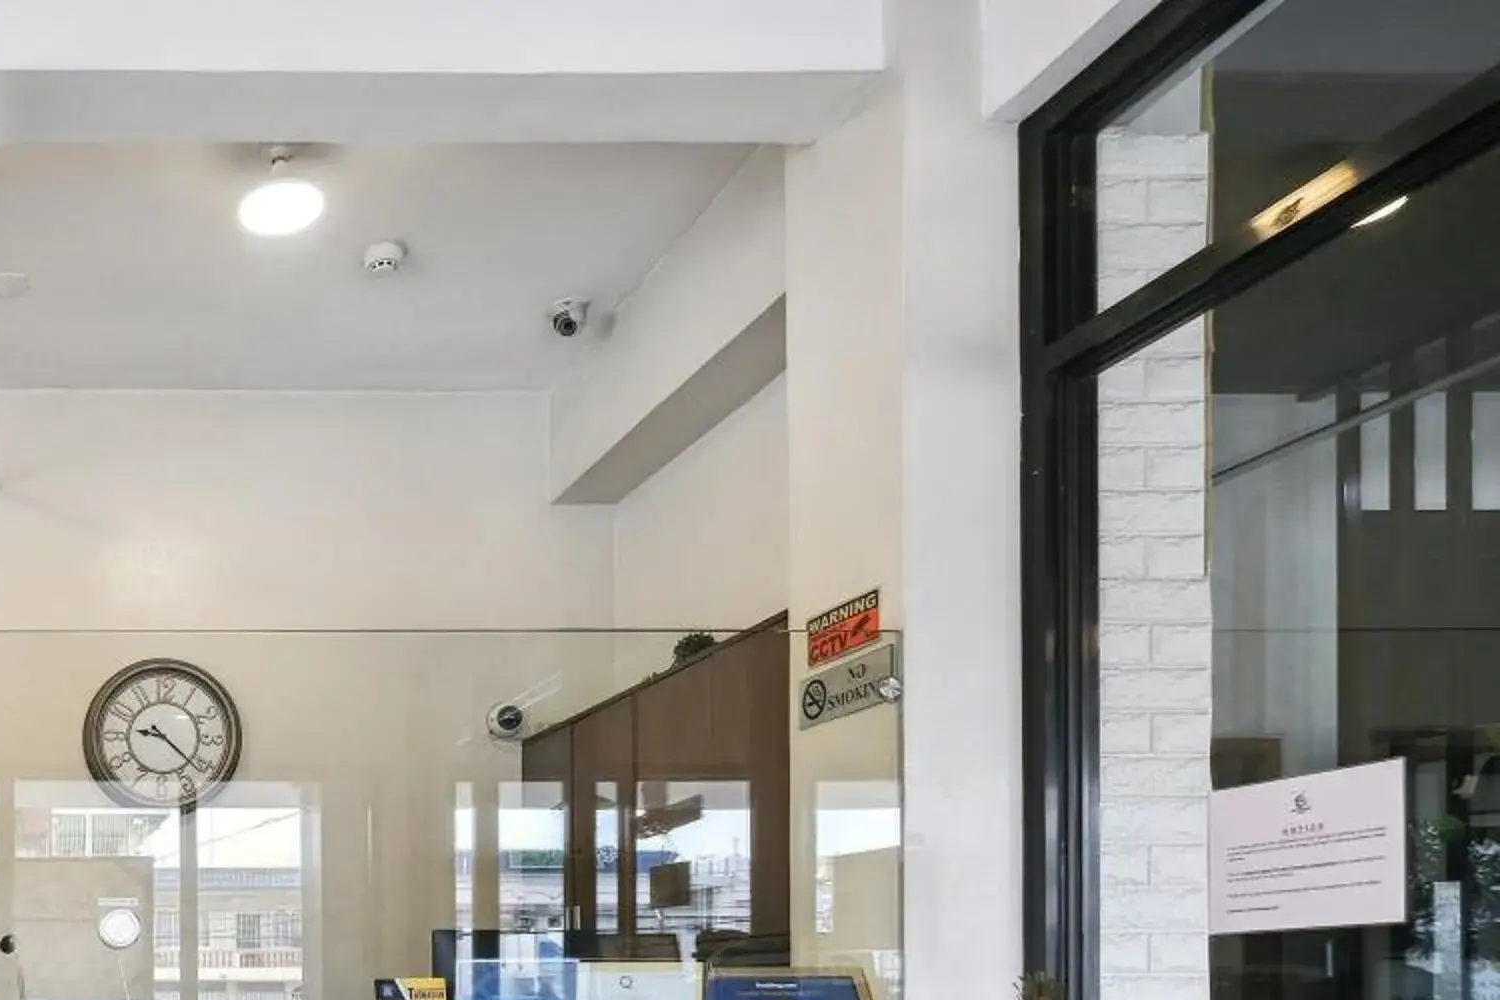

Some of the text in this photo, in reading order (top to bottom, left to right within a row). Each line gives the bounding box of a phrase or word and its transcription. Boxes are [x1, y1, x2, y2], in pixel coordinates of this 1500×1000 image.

[808, 594, 877, 634] WARNING
[811, 632, 851, 662] CCTV
[847, 662, 868, 681] NO
[155, 677, 177, 703] 12
[183, 687, 197, 706] 1
[827, 680, 881, 712] SMOKIN
[109, 702, 134, 721] 10
